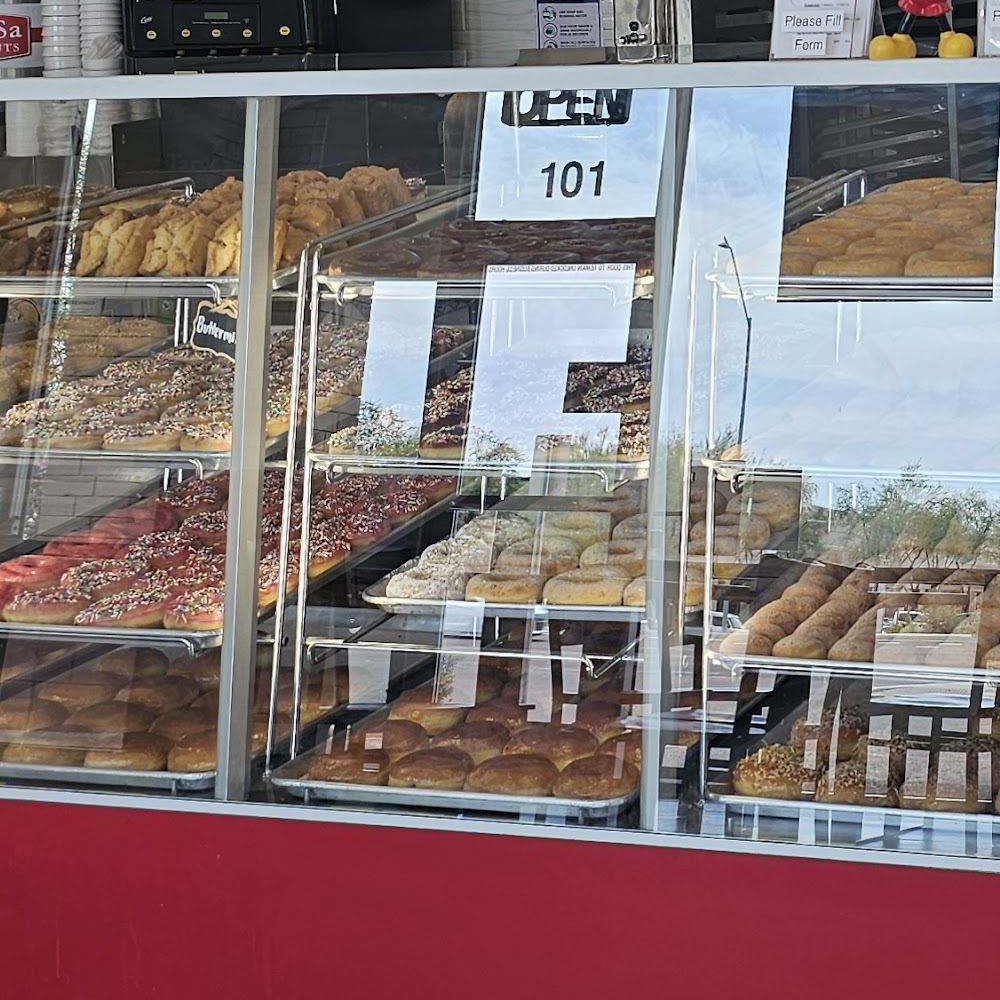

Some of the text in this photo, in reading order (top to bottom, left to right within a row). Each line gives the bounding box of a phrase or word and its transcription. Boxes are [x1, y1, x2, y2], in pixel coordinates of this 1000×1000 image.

[785, 13, 842, 28] Please Fill
[795, 38, 823, 52] Form
[540, 160, 605, 199] 101
